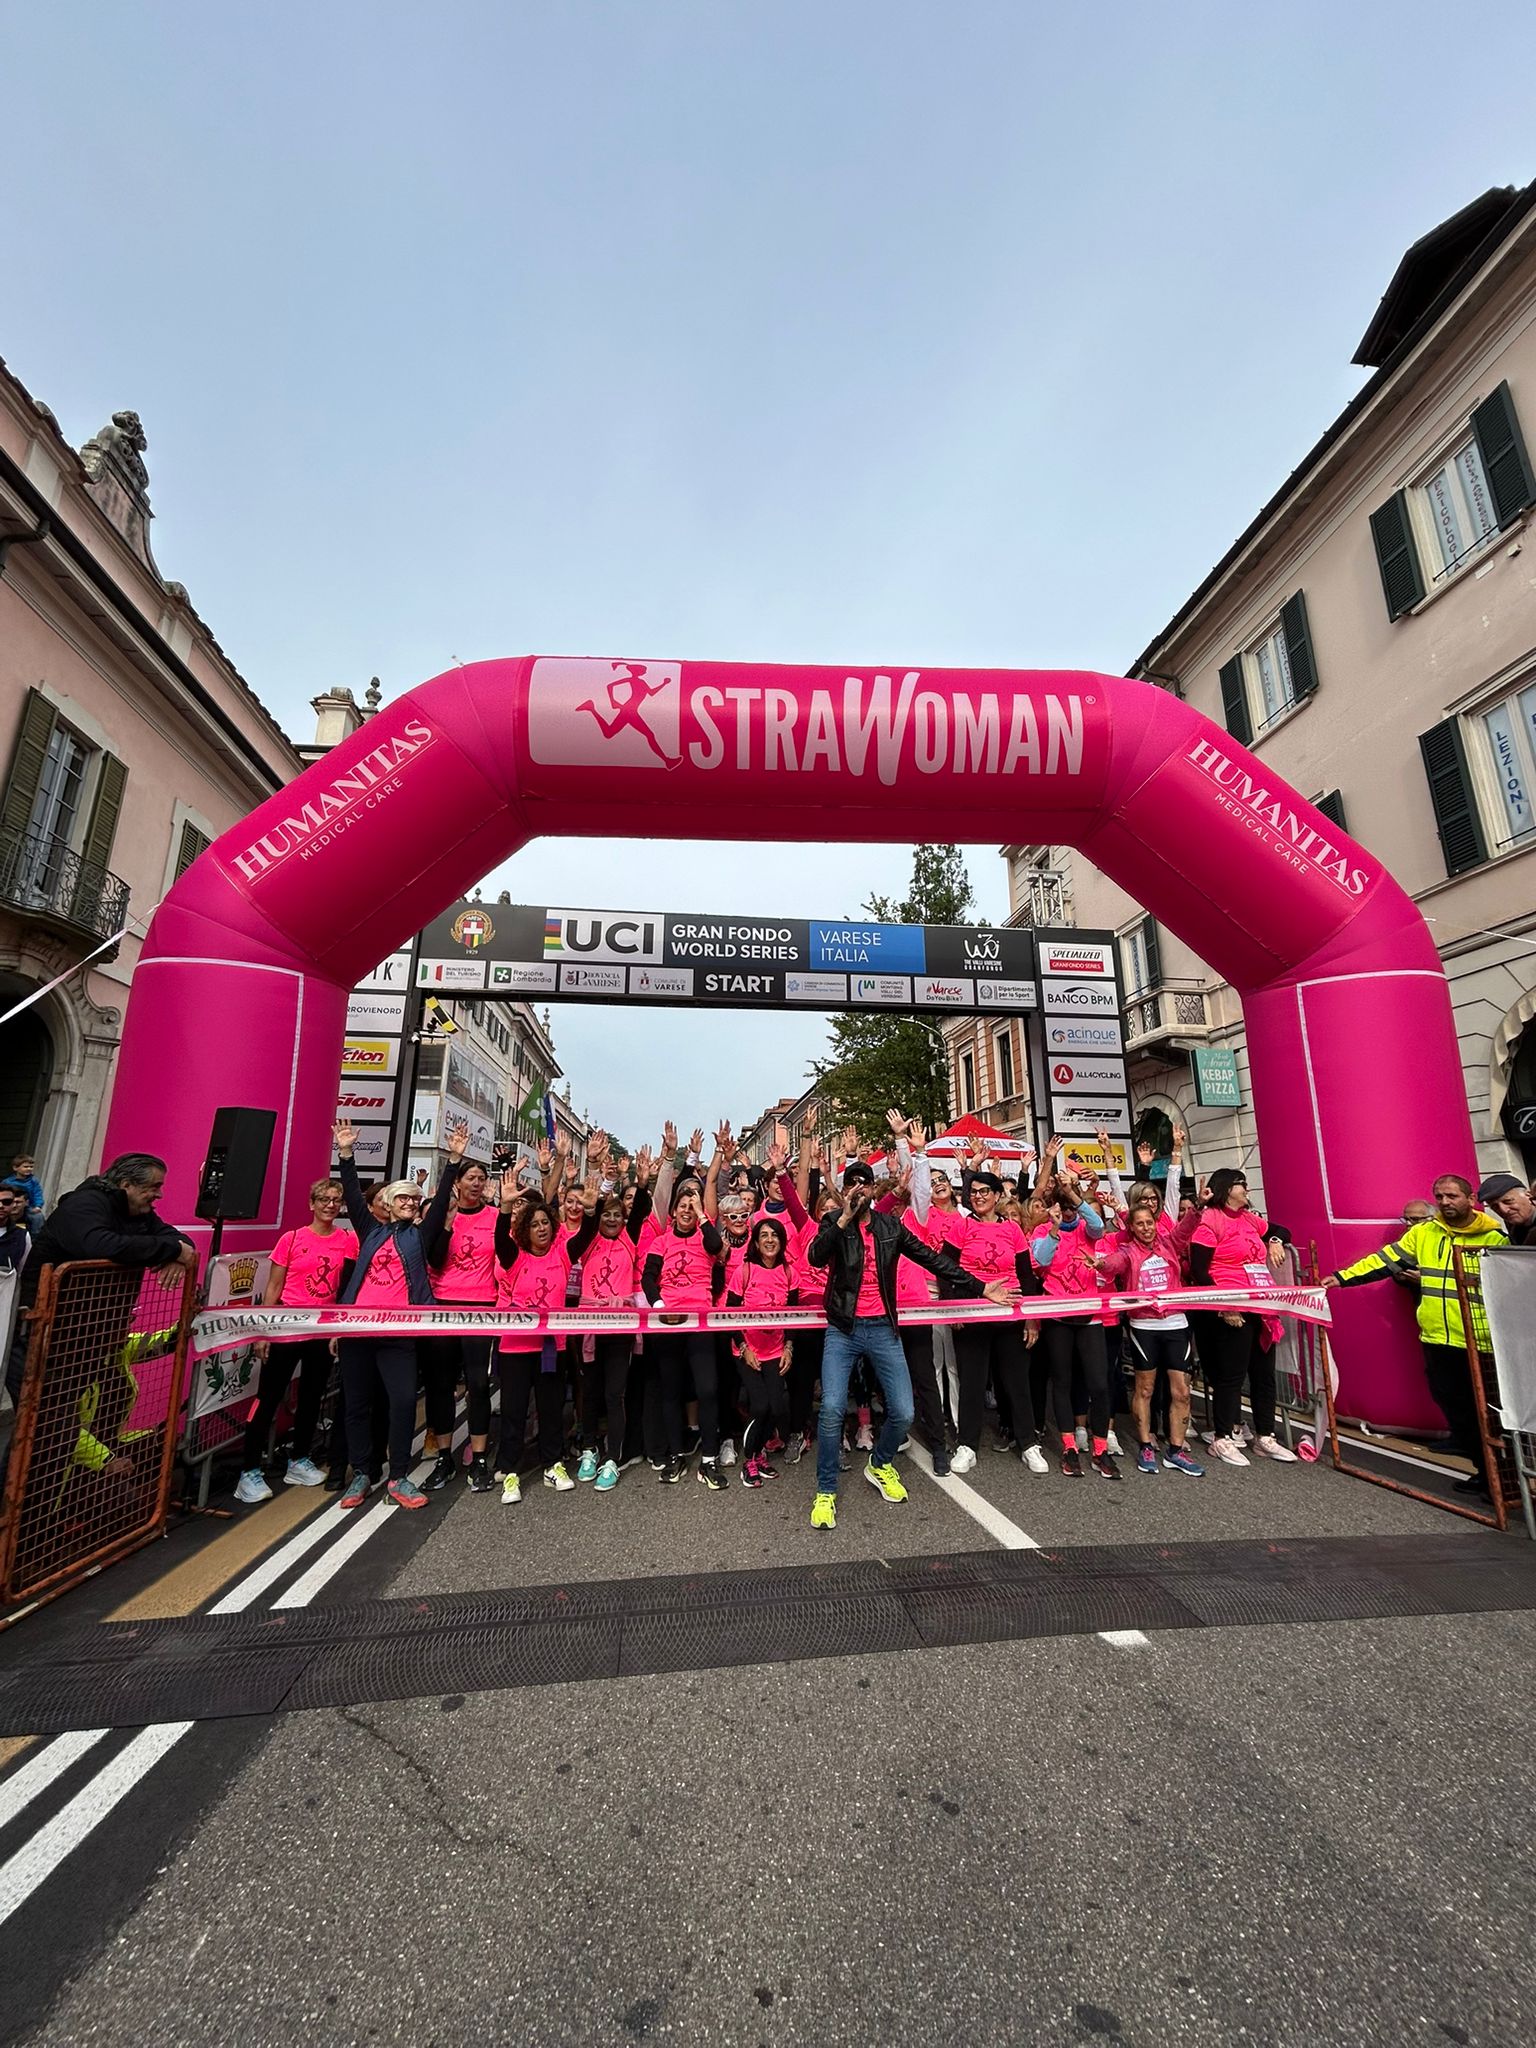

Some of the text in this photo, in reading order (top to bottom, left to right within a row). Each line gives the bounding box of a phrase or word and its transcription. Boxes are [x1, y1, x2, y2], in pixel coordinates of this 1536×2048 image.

[689, 671, 1084, 786] STRAWOMAN
[1496, 731, 1523, 815] LEZIONI
[231, 719, 432, 882] HUMANITAS
[300, 776, 404, 861] MEDICAL CARE
[1187, 737, 1370, 895] HUMANITAS
[1214, 792, 1309, 874] MEDICAL CARE
[566, 919, 655, 955] UCI
[672, 924, 792, 943] GRAN FONDO
[819, 930, 882, 946] VARESE
[671, 941, 799, 960] WORLD SERIES
[821, 947, 870, 963] ITALIA
[1052, 949, 1101, 960] SPECIALIZED
[1051, 961, 1084, 969] GRANFONDO
[513, 969, 544, 977] Regione
[513, 976, 552, 984] Lombardia
[654, 983, 685, 991] VARESE
[705, 973, 775, 993] START
[998, 985, 1034, 993] Dipartimento
[1047, 993, 1089, 1005] BANCO
[1091, 995, 1114, 1006] BPM
[1067, 1027, 1117, 1042] acinque
[1075, 1071, 1122, 1080] ALL4CYCLING
[1201, 1068, 1235, 1081] KEBAP
[1204, 1082, 1236, 1095] PIZZA
[1150, 1274, 1168, 1284] 2024
[430, 1312, 534, 1325] HUMANITAS
[263, 1325, 282, 1333] CARE
